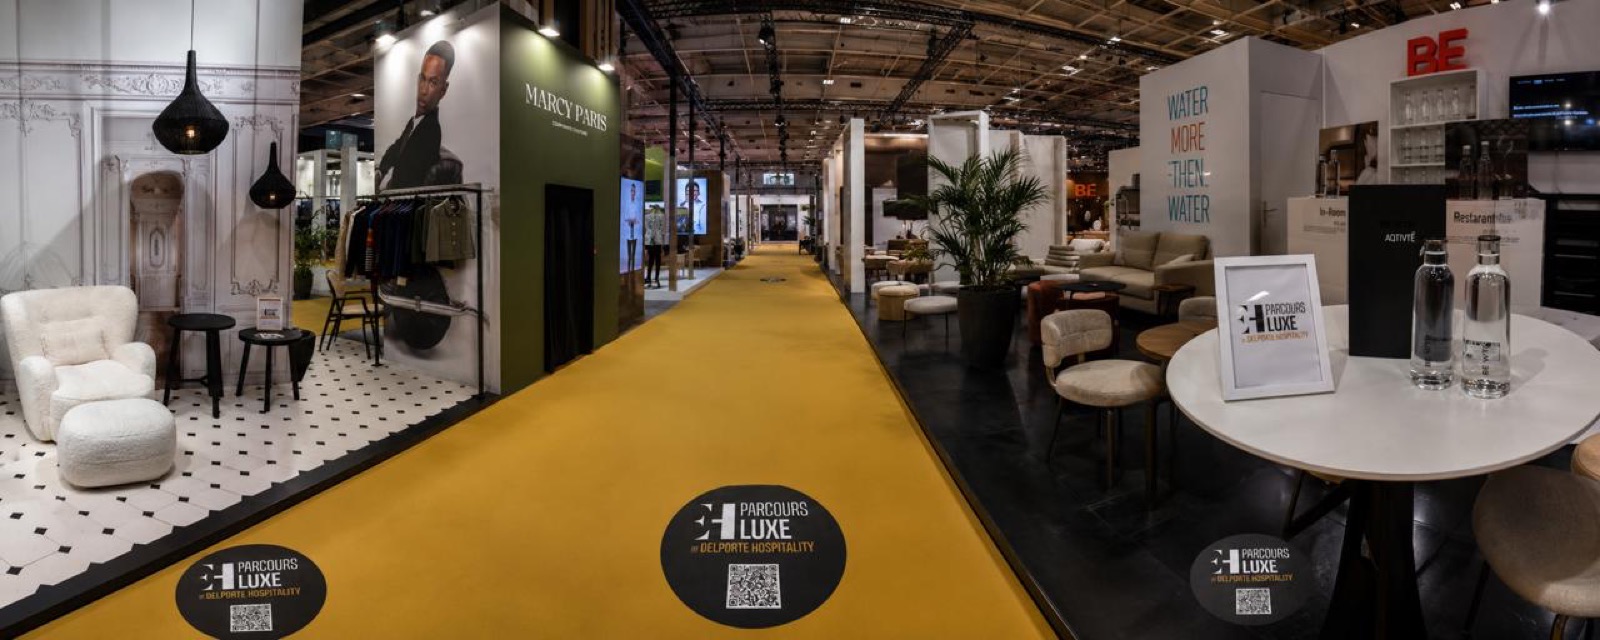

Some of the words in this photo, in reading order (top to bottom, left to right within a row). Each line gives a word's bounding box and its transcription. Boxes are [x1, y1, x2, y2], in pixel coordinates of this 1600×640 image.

[1407, 28, 1469, 76] BE
[525, 83, 573, 119] MARCY
[575, 104, 607, 132] PARIS
[1167, 85, 1209, 120] WATER
[1170, 121, 1206, 154] MORE
[1168, 194, 1210, 223] WATER
[1265, 301, 1306, 316] PARCOURS
[1266, 316, 1298, 332] LUXE
[740, 501, 809, 517] PARCOURS
[740, 519, 792, 540] LUXE
[700, 542, 749, 554] DELPORTE
[751, 541, 815, 553] HOSPITALITY
[1241, 548, 1290, 560] PARCOURS
[238, 558, 299, 573] PARCOURS
[1242, 559, 1279, 574] LUXE
[238, 572, 282, 589] LUXE
[205, 590, 246, 600] DELPORTE
[248, 587, 301, 598] HOSPITALITY
